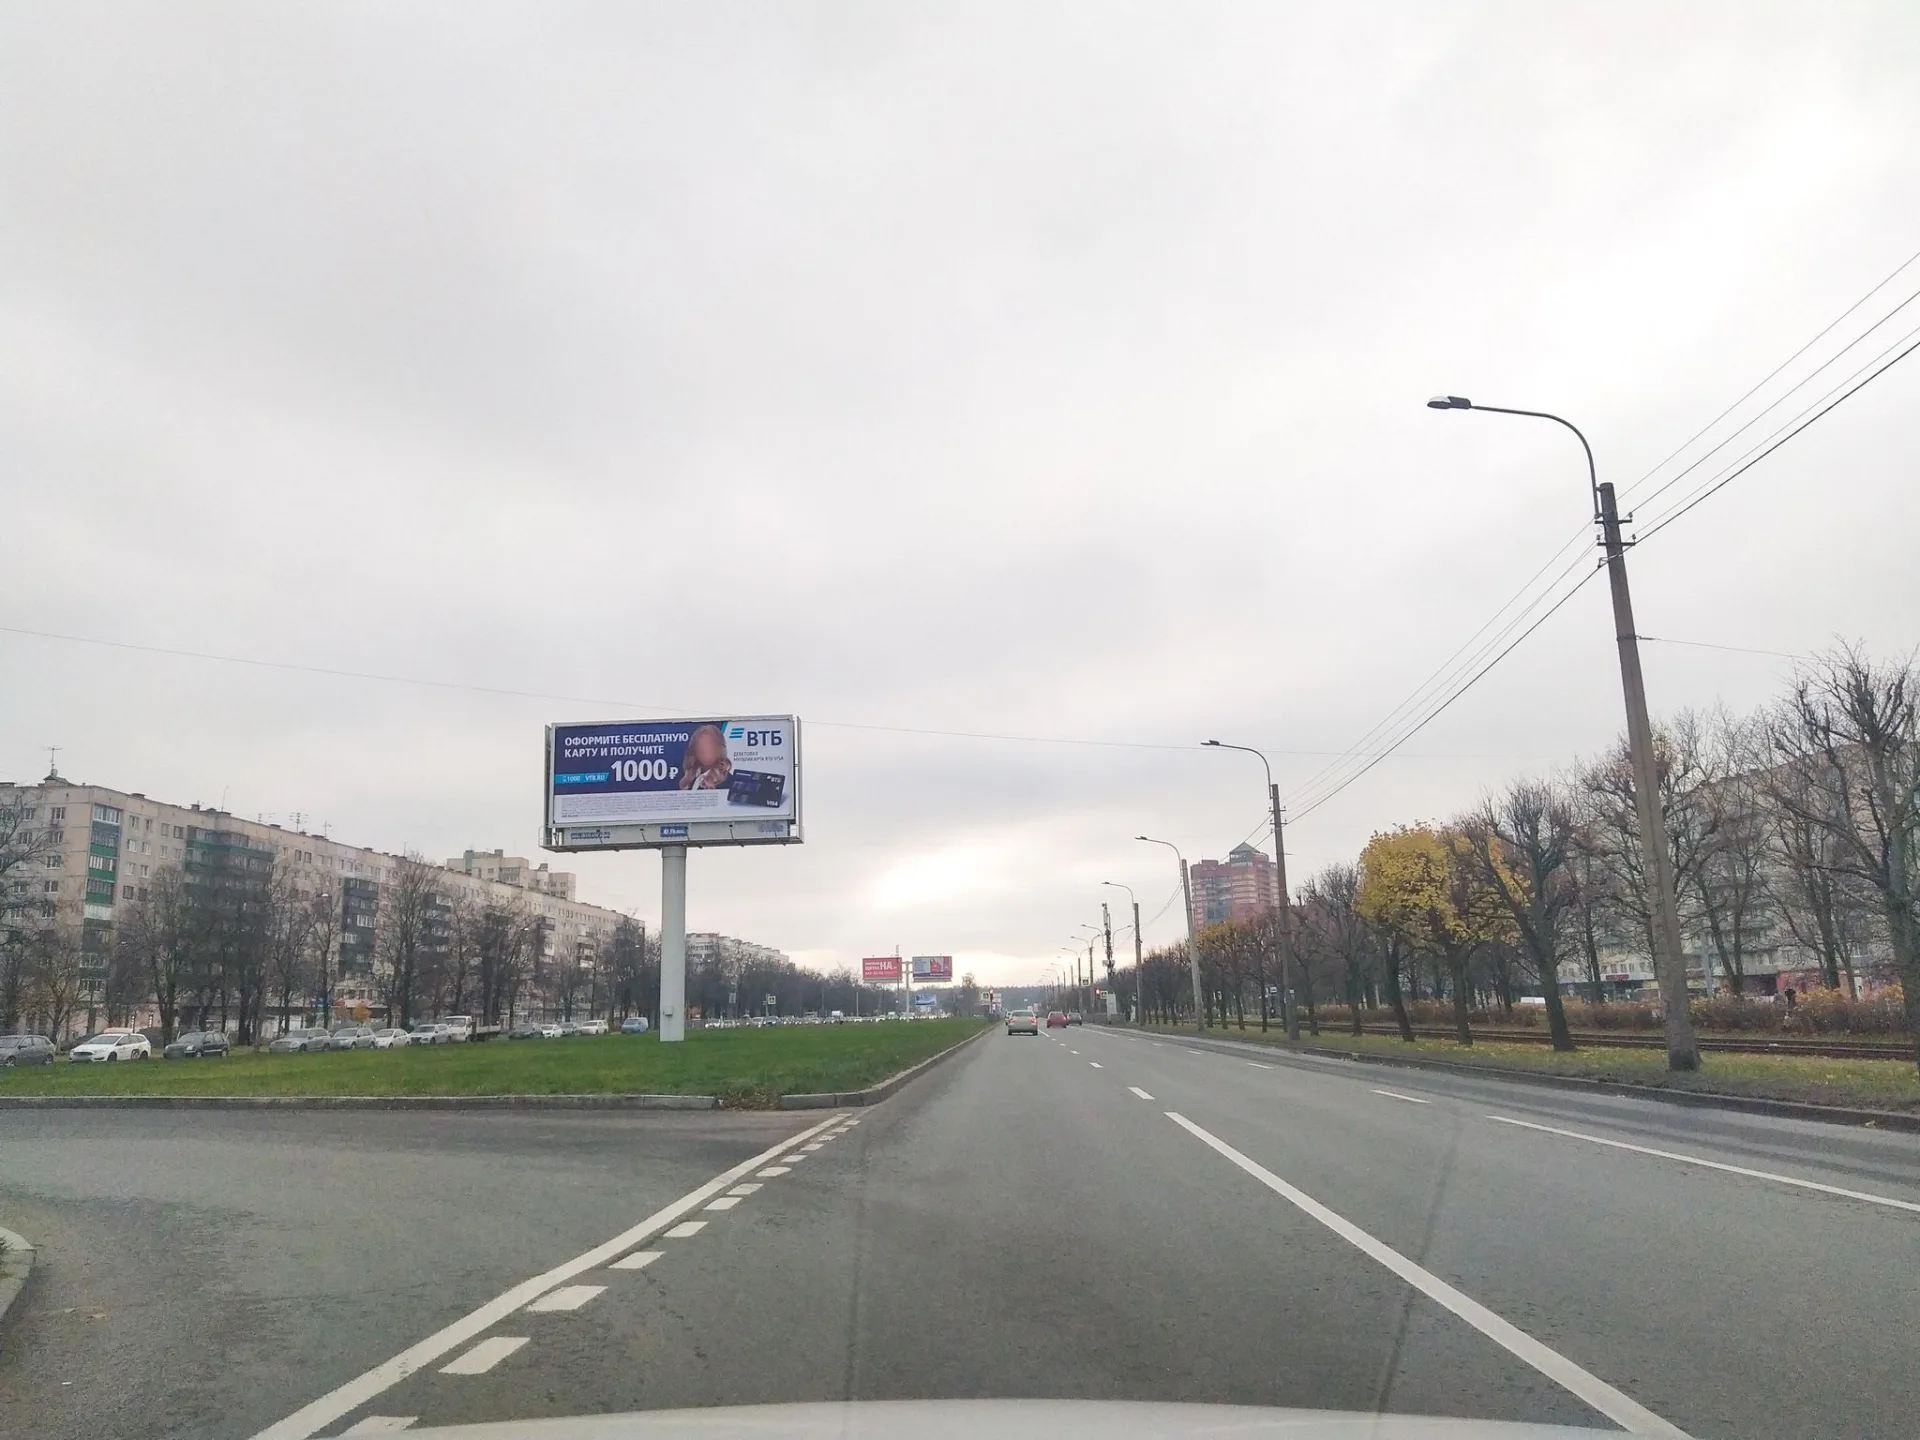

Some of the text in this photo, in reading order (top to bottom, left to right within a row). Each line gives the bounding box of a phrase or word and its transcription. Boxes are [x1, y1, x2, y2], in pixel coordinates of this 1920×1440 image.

[564, 733, 689, 746] ОФОРМИТЕ БЕСПЛАТНУЮ
[747, 730, 783, 747] ВТБ
[564, 745, 665, 758] КАРТУ И ПОЛУЧИТЕ
